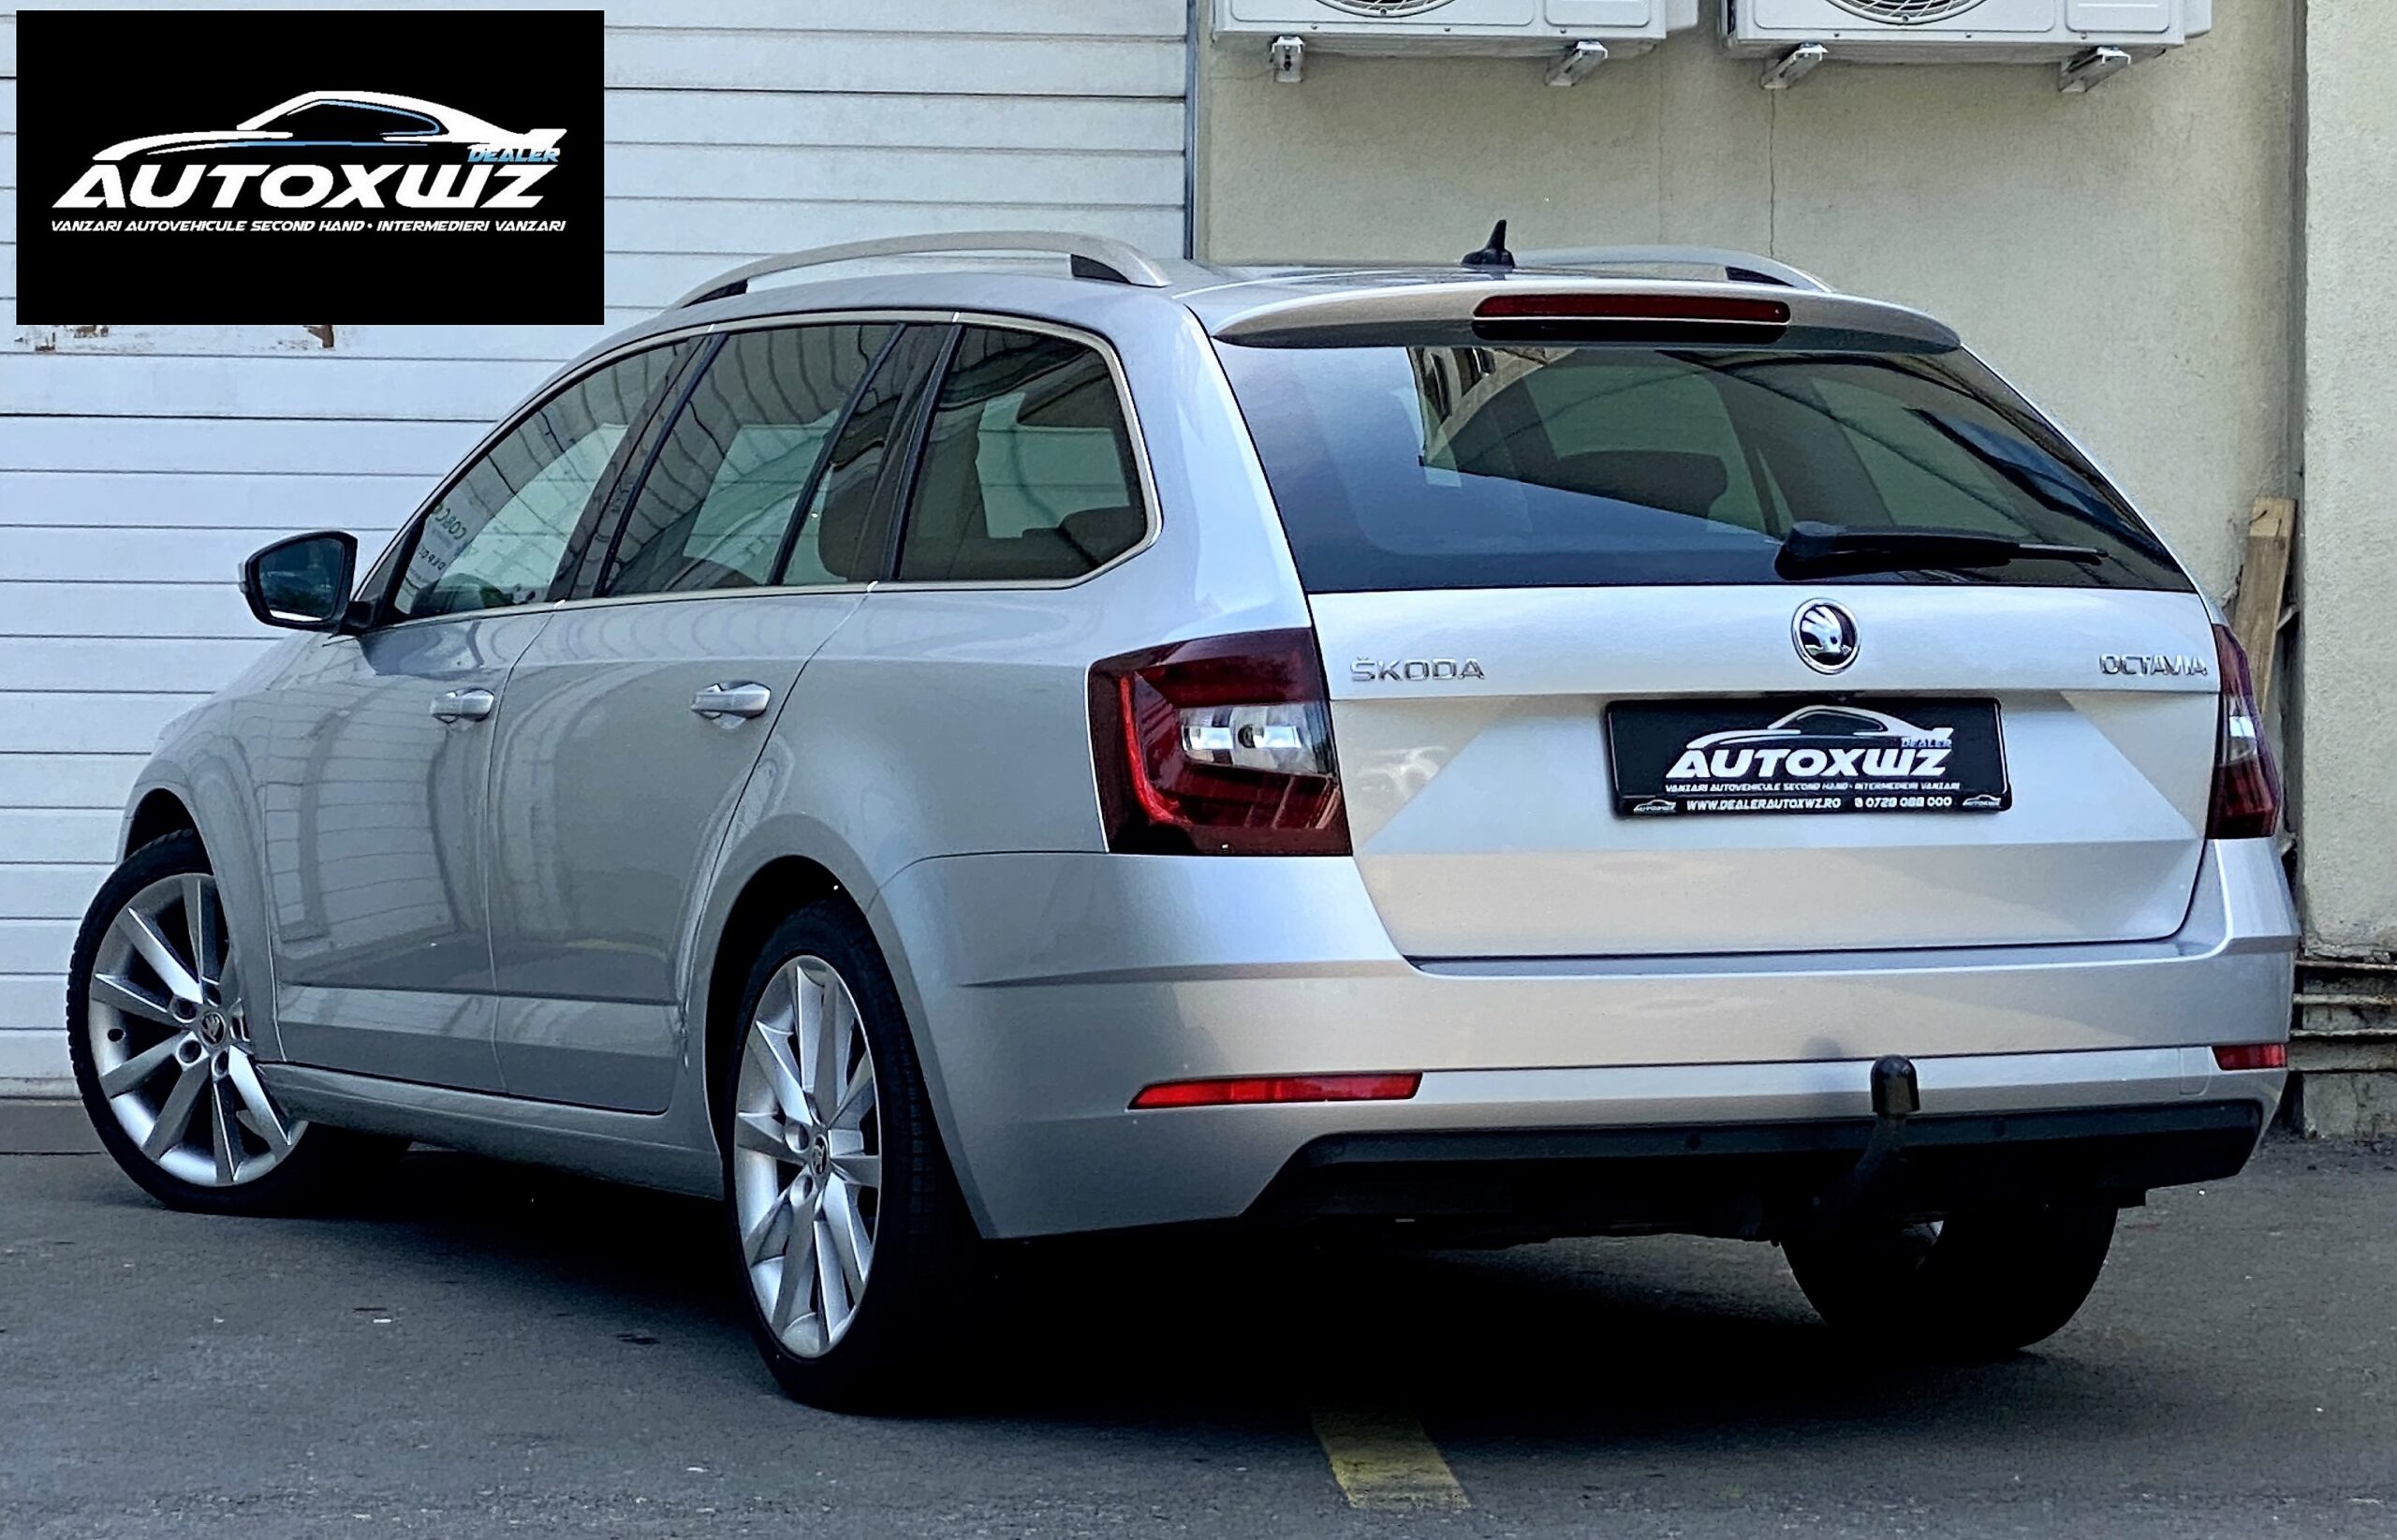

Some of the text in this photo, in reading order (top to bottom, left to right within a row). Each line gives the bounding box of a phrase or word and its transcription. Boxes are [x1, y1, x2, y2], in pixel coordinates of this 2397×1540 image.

[1350, 656, 1485, 682] ŠKODA
[2099, 654, 2208, 676] OCTAVIA
[1901, 738, 1952, 748] DEALER
[1666, 748, 1952, 778] AUTOXWZ
[1665, 784, 1708, 793] VANZARI
[1783, 783, 1820, 791] SECOND
[1920, 782, 1960, 790] VANZARI
